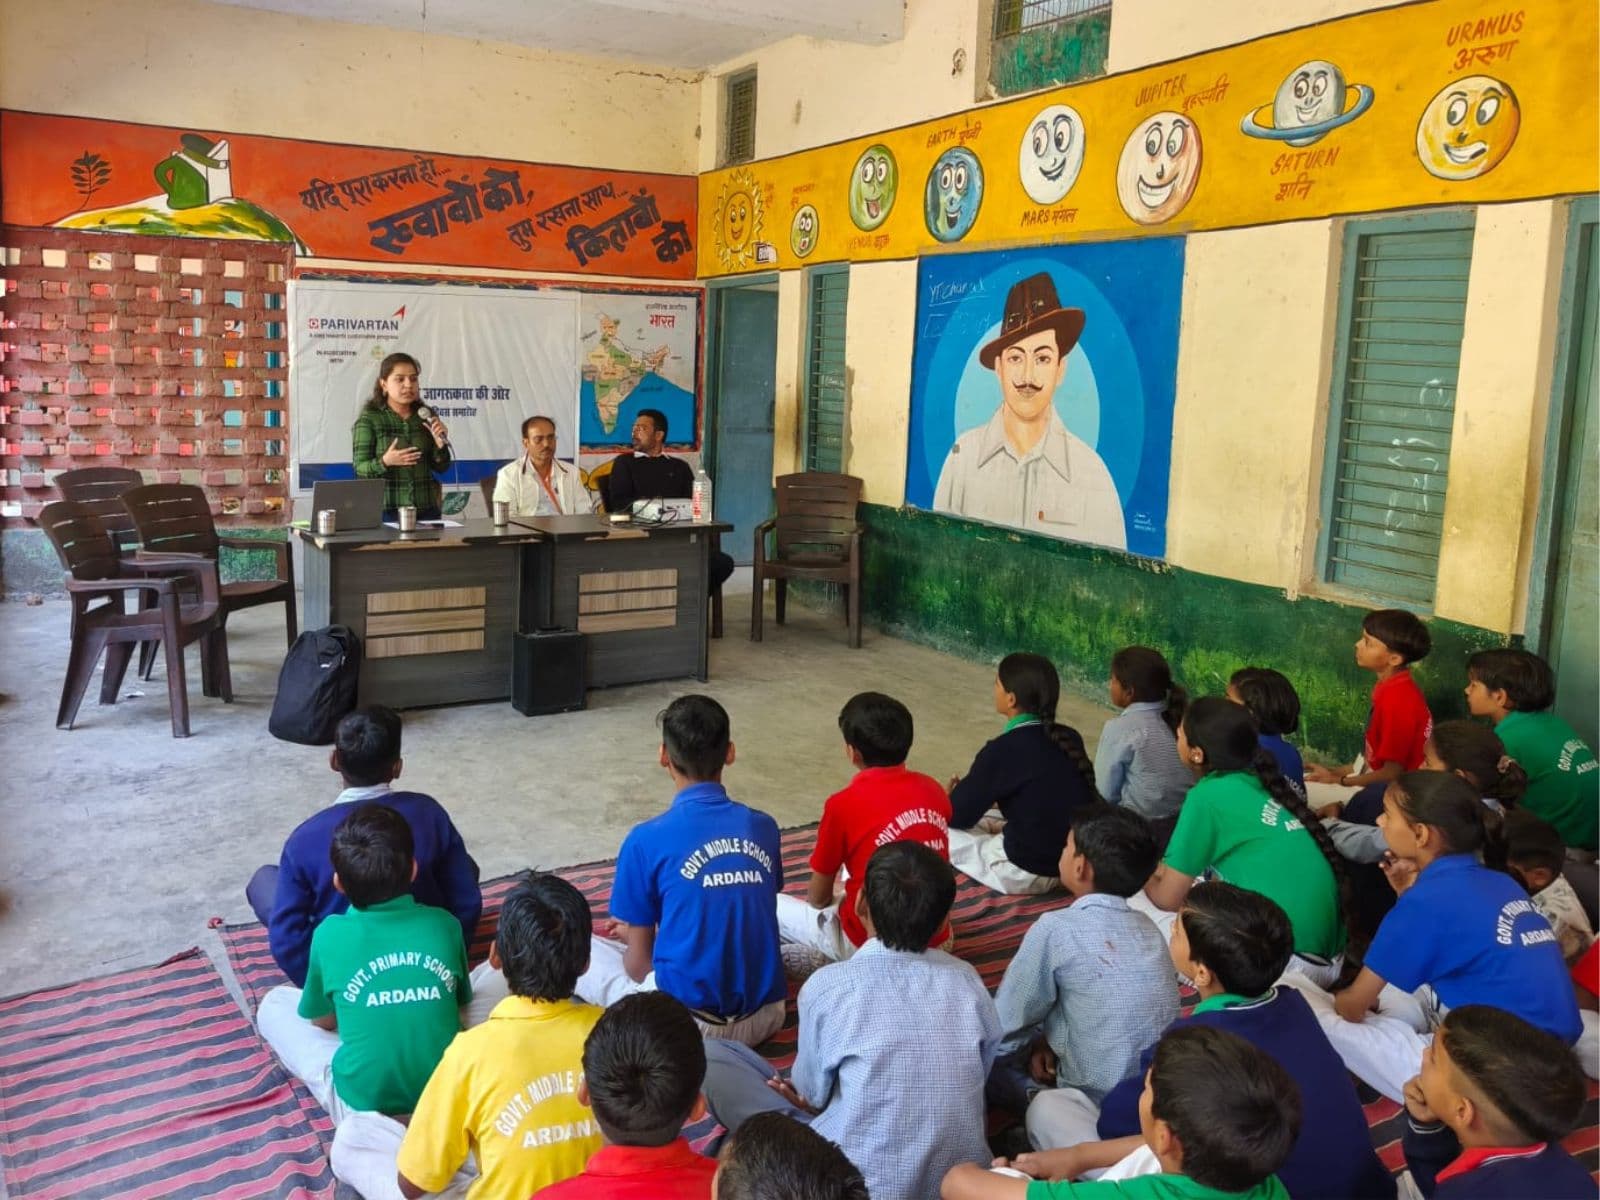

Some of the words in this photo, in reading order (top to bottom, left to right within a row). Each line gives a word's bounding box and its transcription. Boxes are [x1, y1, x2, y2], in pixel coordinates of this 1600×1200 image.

[1447, 10, 1525, 47] URANUS
[1135, 74, 1187, 107] JUPITER
[927, 127, 956, 148] EARTH
[1271, 147, 1339, 176] SATURN
[299, 178, 348, 211] यदि
[369, 163, 418, 191] करना
[1021, 210, 1048, 227] MARS
[507, 218, 537, 252] तुम
[652, 220, 694, 265] को
[321, 318, 399, 330] PARIVARTAN
[650, 314, 675, 328] भारत
[475, 385, 490, 400] की
[491, 386, 511, 400] ओर
[895, 808, 927, 830] MIDDLE
[680, 850, 709, 880] GOVT.
[704, 838, 741, 859] MIDDLE
[742, 839, 773, 873] SCHOOL
[702, 870, 763, 888] ARDANA
[1496, 914, 1515, 945] GOVT.
[343, 968, 372, 1003] GOVT.
[368, 952, 422, 975] PRIMARY
[423, 954, 456, 993] SCHOOL
[366, 986, 441, 1007] ARDANA
[494, 1093, 532, 1137] GOVT.
[527, 1071, 575, 1104] MIDDLE
